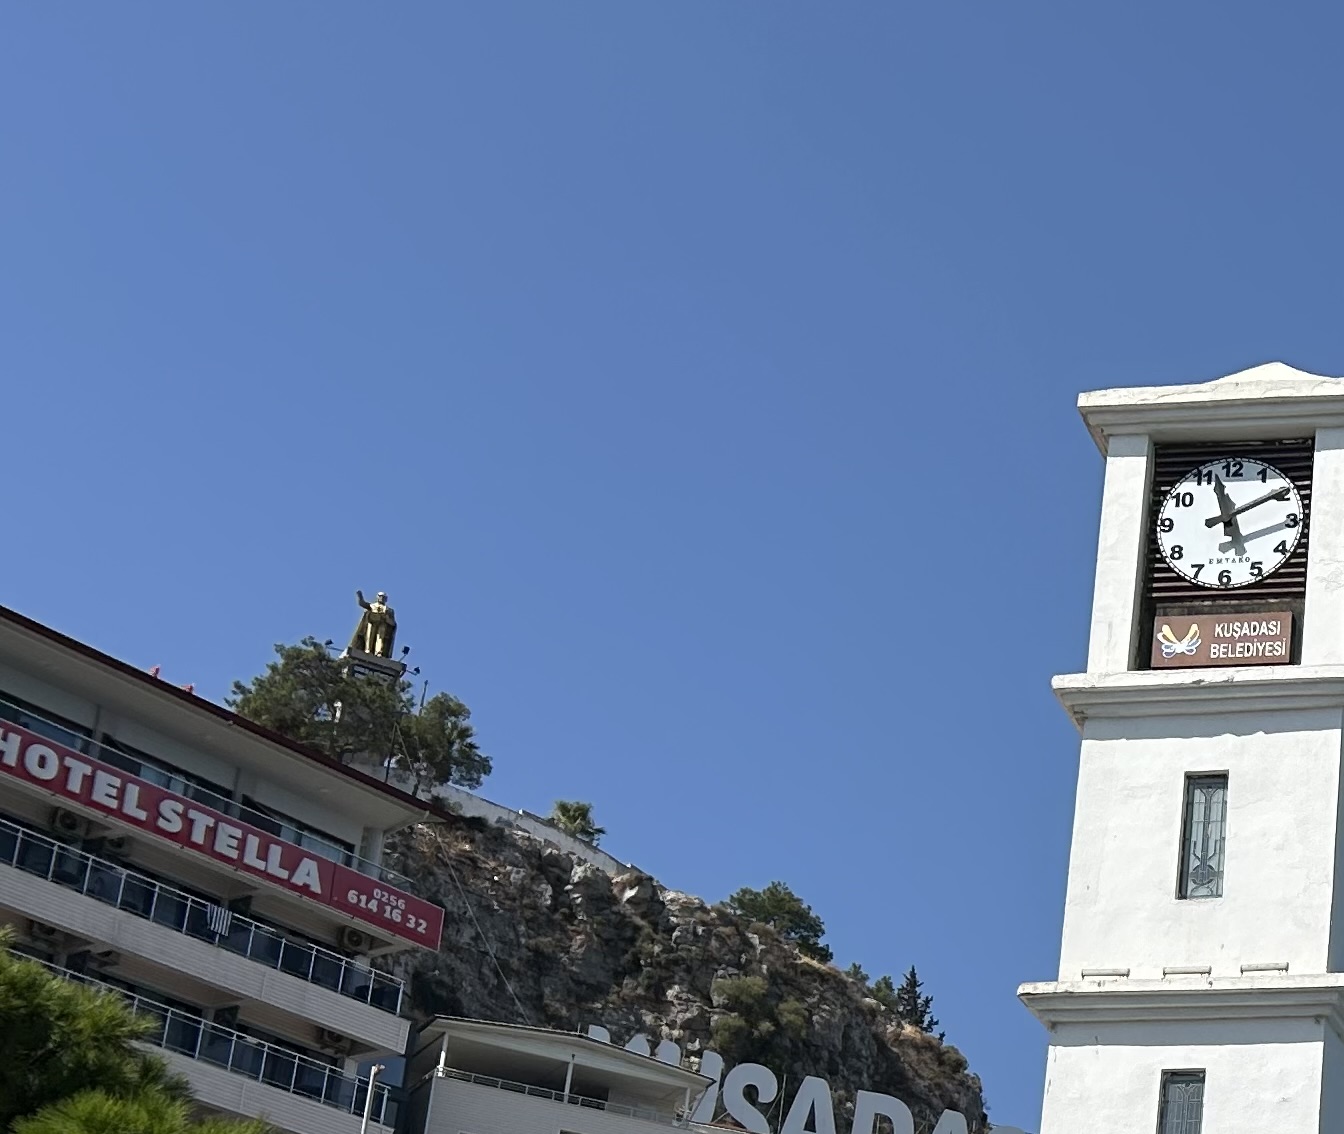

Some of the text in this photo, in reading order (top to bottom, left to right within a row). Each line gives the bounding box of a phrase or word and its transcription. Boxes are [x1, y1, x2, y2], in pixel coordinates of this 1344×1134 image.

[1194, 469, 1214, 486] 11
[1222, 461, 1244, 478] 12
[1256, 467, 1268, 483] 1
[1173, 492, 1194, 508] 10
[1160, 518, 1175, 533] 9
[1285, 513, 1298, 528] 3
[1169, 544, 1184, 560] 8
[1273, 540, 1288, 556] 4
[1190, 563, 1205, 580] 7
[1217, 569, 1232, 586] 6
[1249, 561, 1264, 578] 5
[1214, 620, 1281, 639] KUŞADASI
[1209, 638, 1287, 660] BELEDİYESİ
[0, 727, 322, 895] HOTEL STELLA
[373, 888, 406, 910] 0256
[347, 889, 428, 935] 614 16 32
